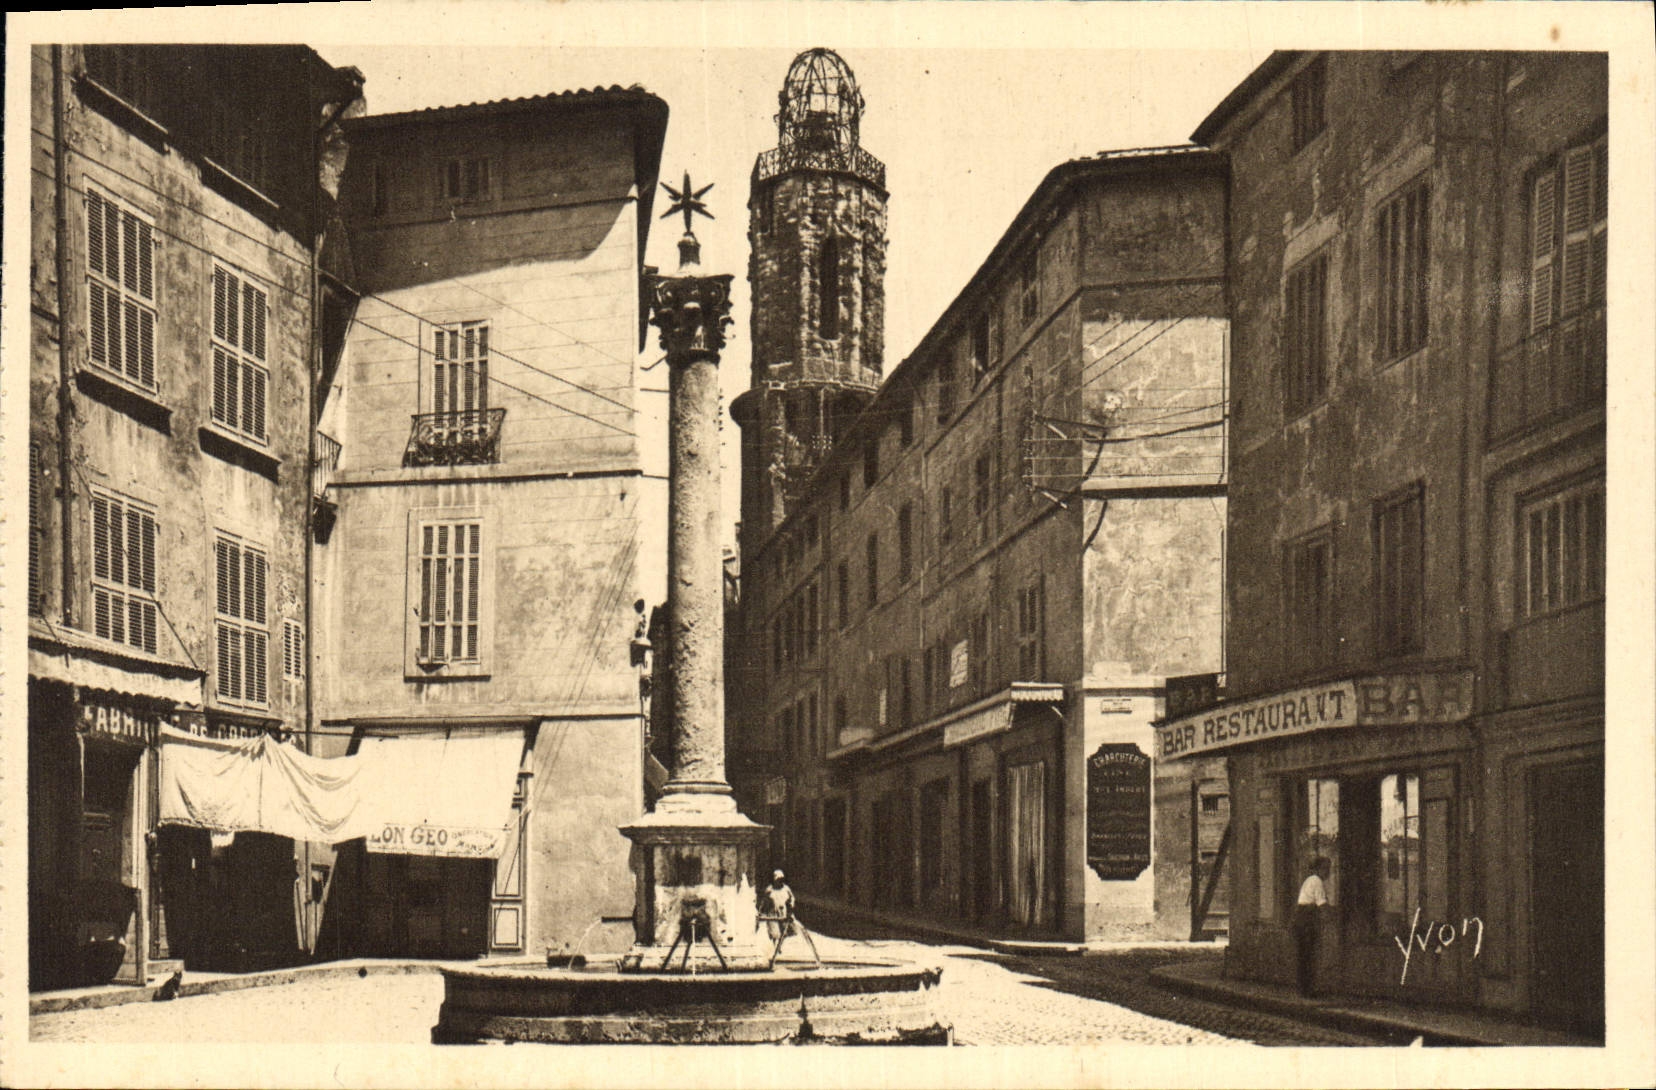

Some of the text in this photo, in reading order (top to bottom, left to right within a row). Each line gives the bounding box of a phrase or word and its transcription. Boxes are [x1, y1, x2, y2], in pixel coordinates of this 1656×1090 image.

[1361, 674, 1468, 720] BAR
[1163, 690, 1346, 757] BAR RESTAURANT
[410, 826, 448, 847] GEO
